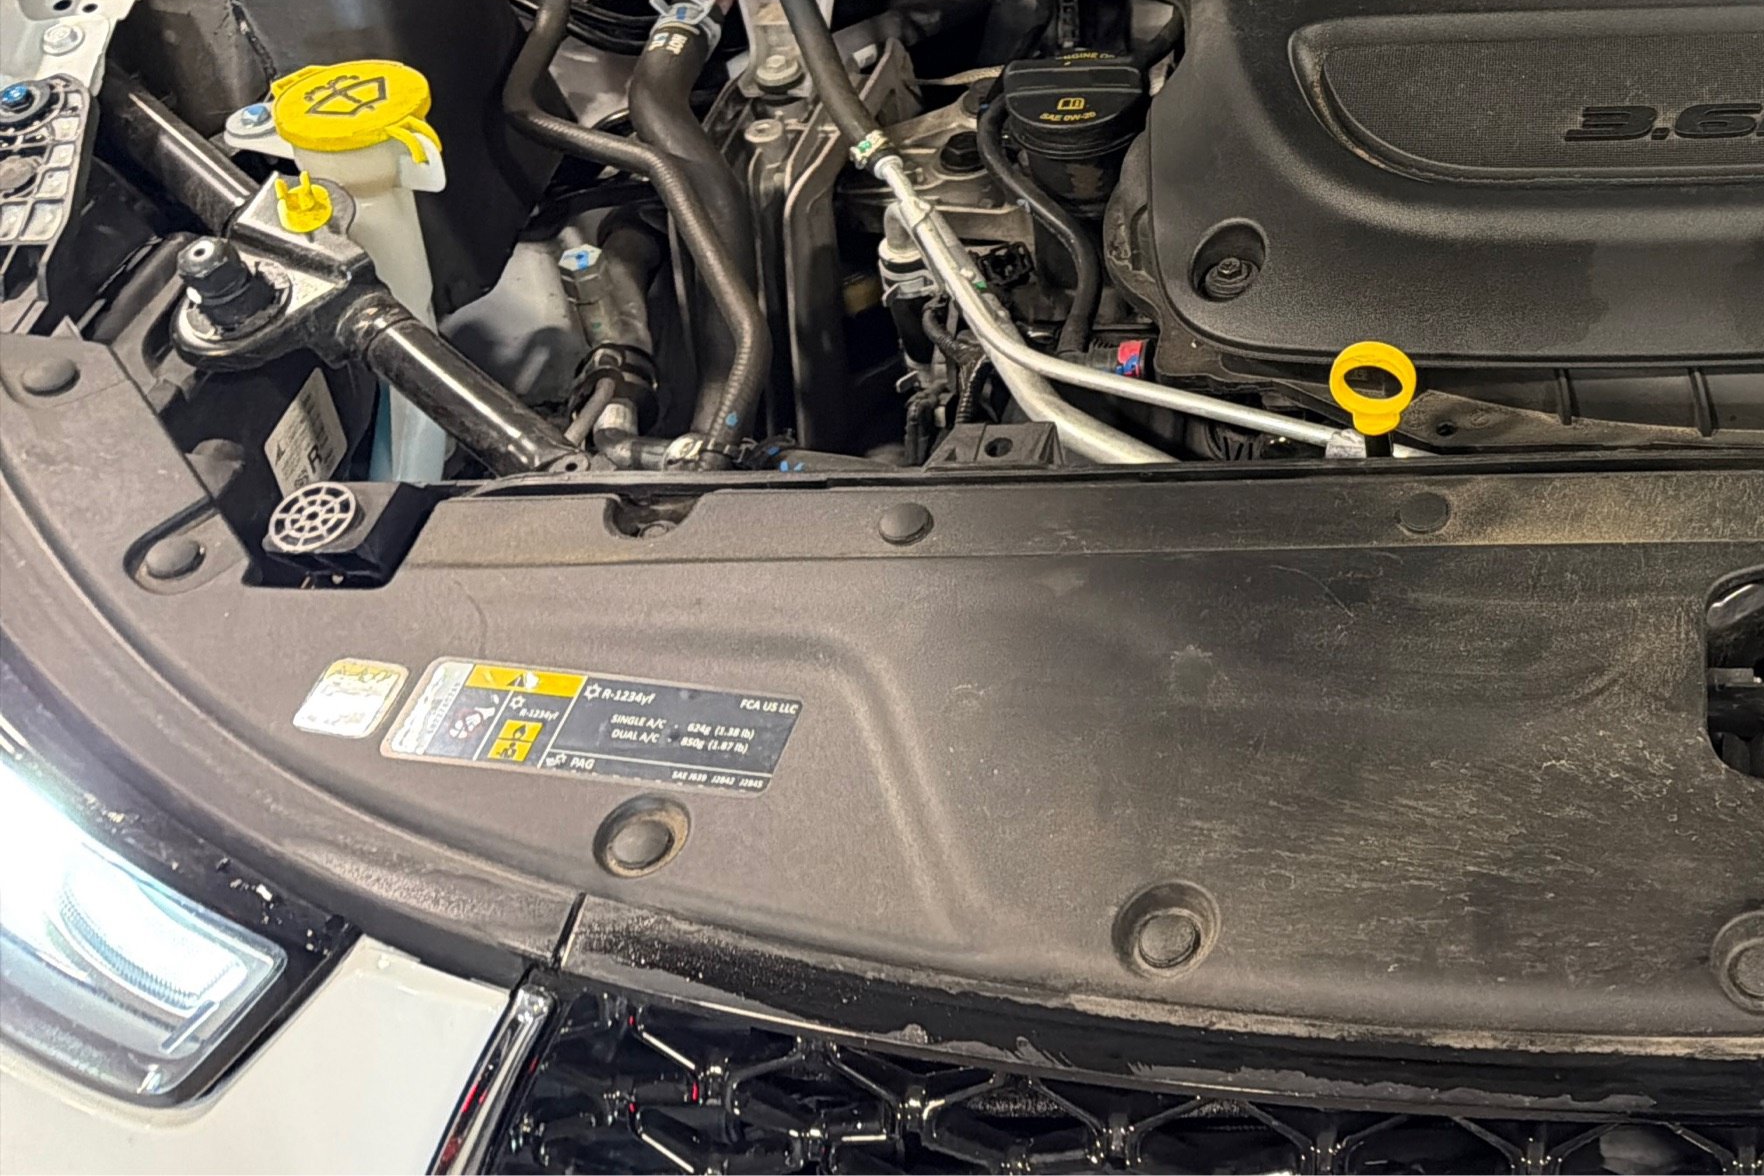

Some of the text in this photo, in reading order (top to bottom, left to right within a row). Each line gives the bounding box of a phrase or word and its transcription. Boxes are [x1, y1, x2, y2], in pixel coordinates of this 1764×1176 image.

[1040, 112, 1063, 122] SAE
[601, 688, 656, 706] R-1234yf
[740, 698, 799, 715] FCA US LLC
[610, 714, 647, 727] SINGLE
[645, 718, 667, 730] A/C
[611, 729, 638, 741] DUAL
[638, 732, 660, 744] A/C
[570, 757, 596, 771] PAG
